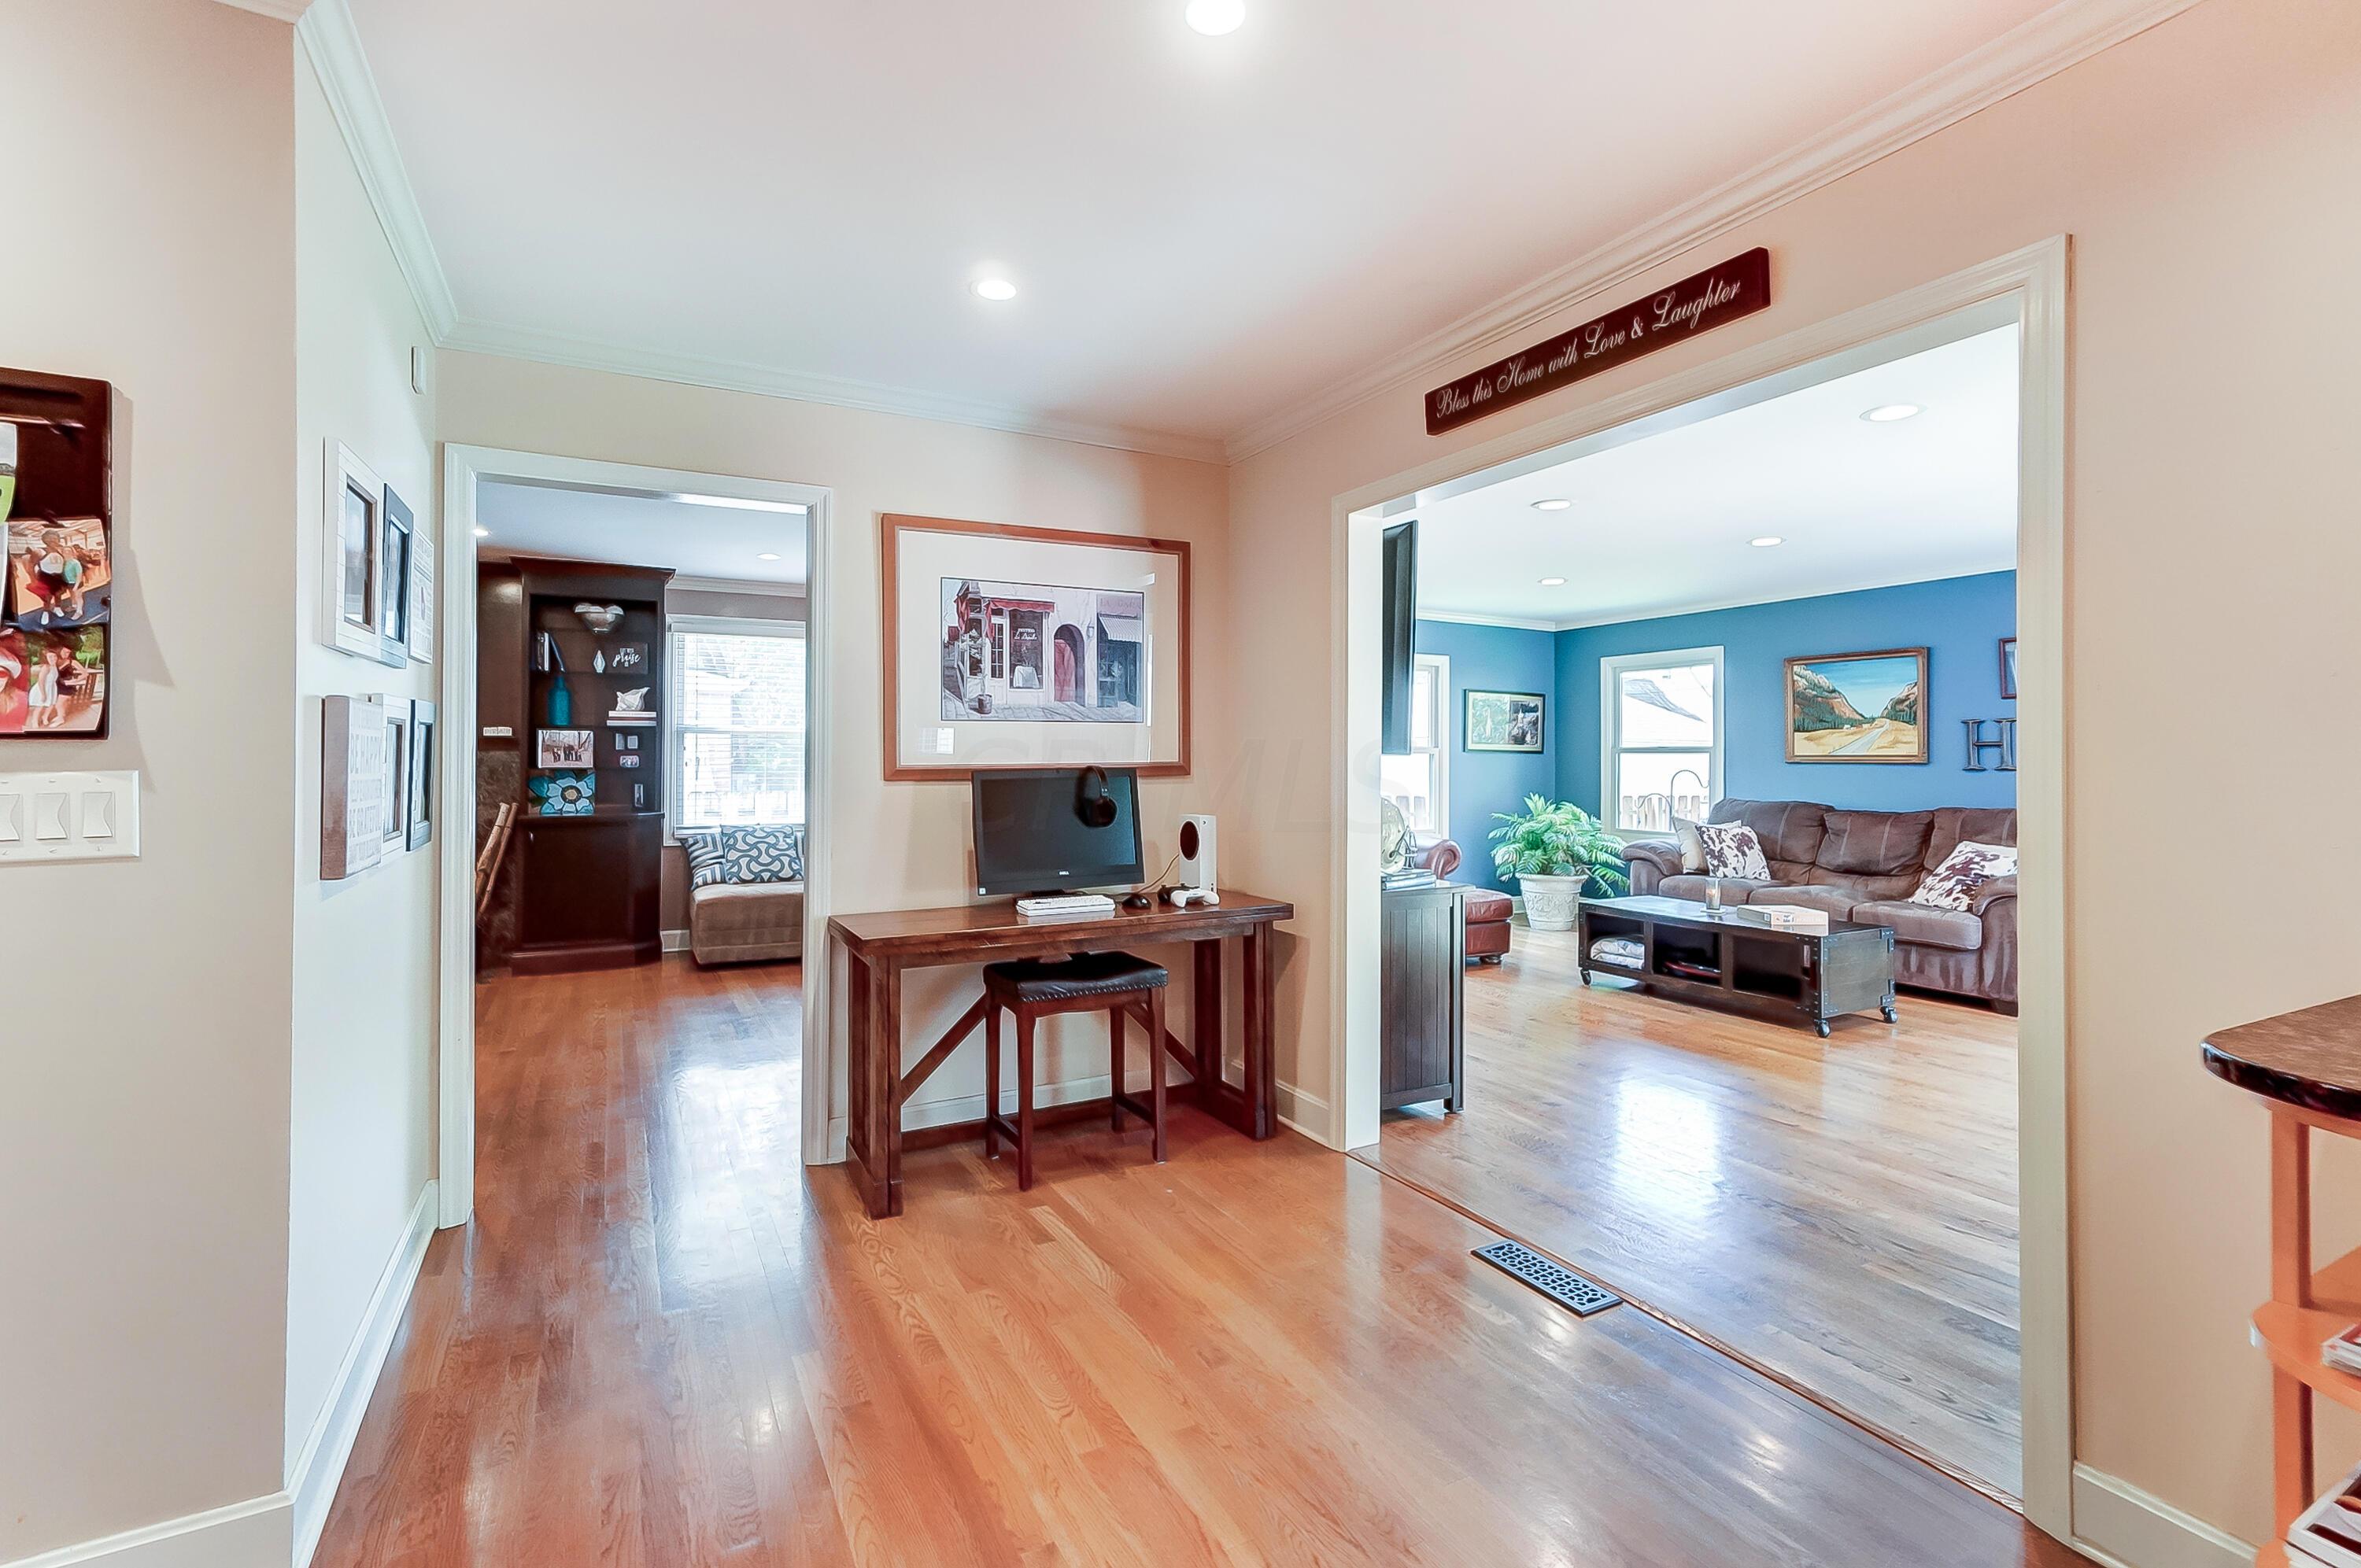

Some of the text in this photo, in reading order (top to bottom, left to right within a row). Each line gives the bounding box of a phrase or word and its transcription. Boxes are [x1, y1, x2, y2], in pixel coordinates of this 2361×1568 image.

[1435, 275, 1741, 419] Bless this Home with Love & Laughter
